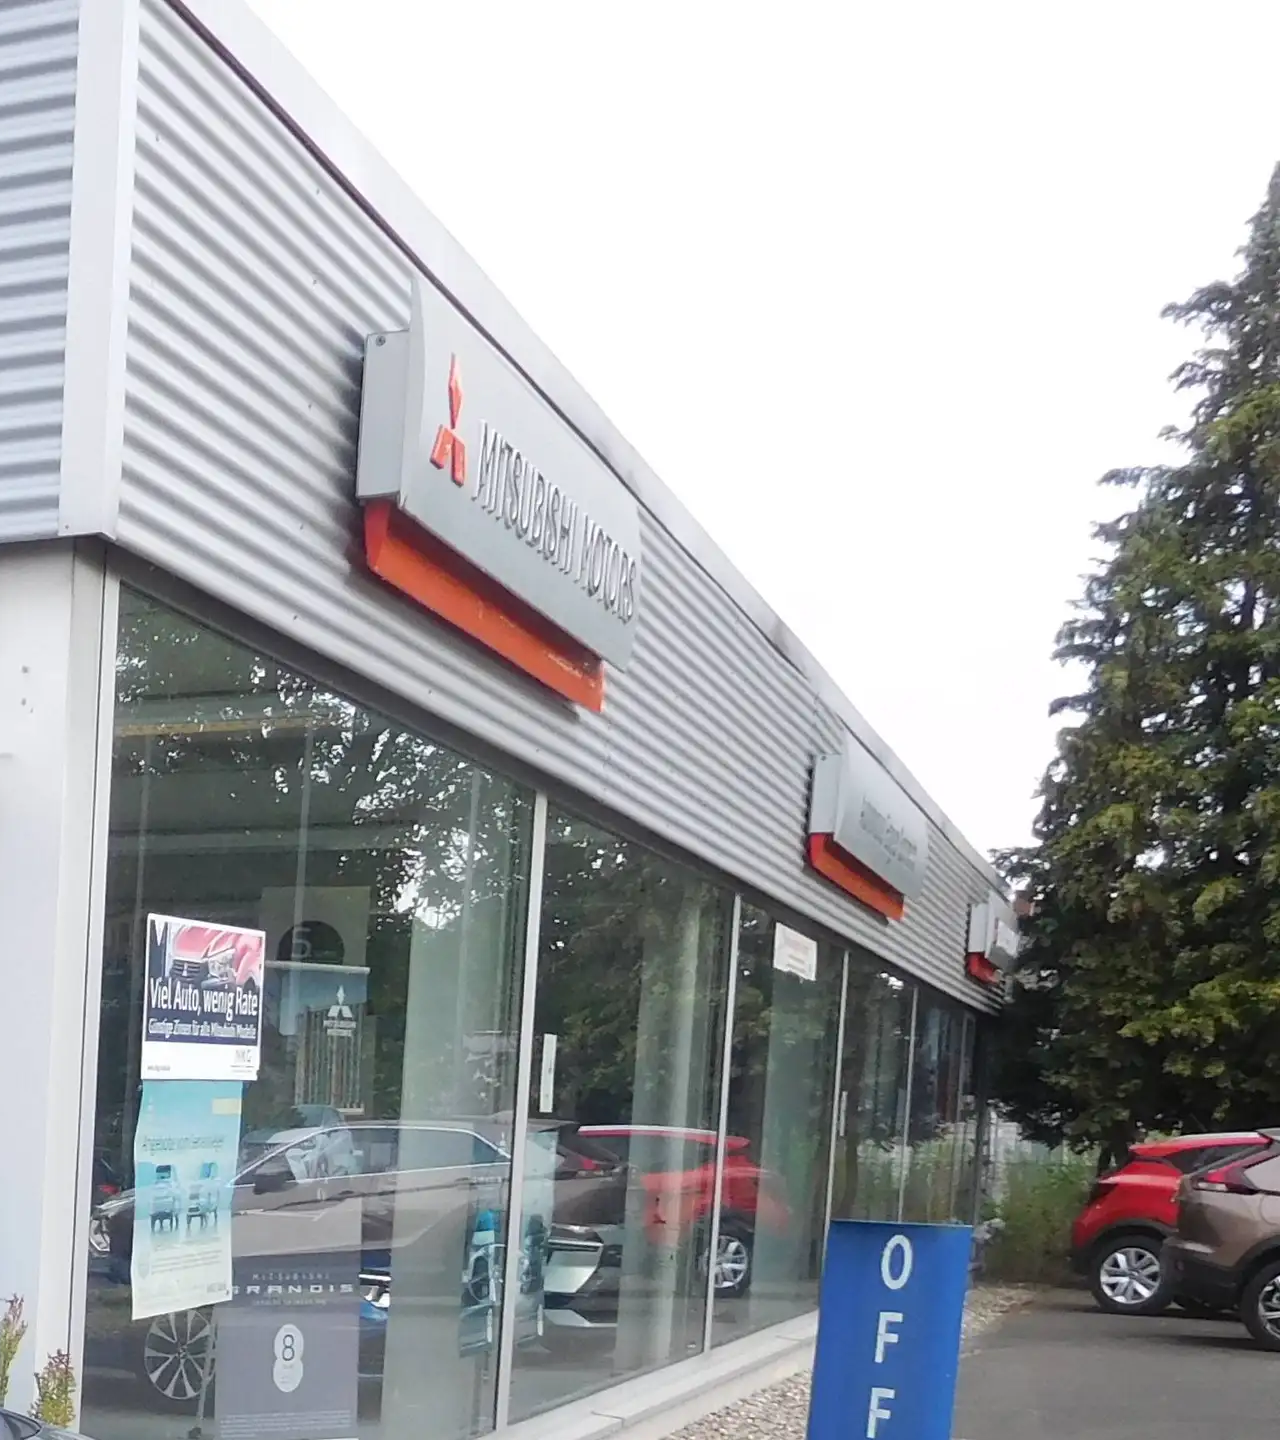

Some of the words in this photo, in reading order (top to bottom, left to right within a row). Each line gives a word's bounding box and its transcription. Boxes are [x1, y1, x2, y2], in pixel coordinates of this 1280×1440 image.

[471, 418, 579, 575] MITSUBISHI
[573, 512, 637, 625] MOTORS
[150, 975, 172, 1009] Viel
[174, 980, 202, 1015] Auto,
[203, 985, 234, 1023] wenig
[235, 986, 258, 1016] Rate
[281, 1333, 296, 1362] 8
